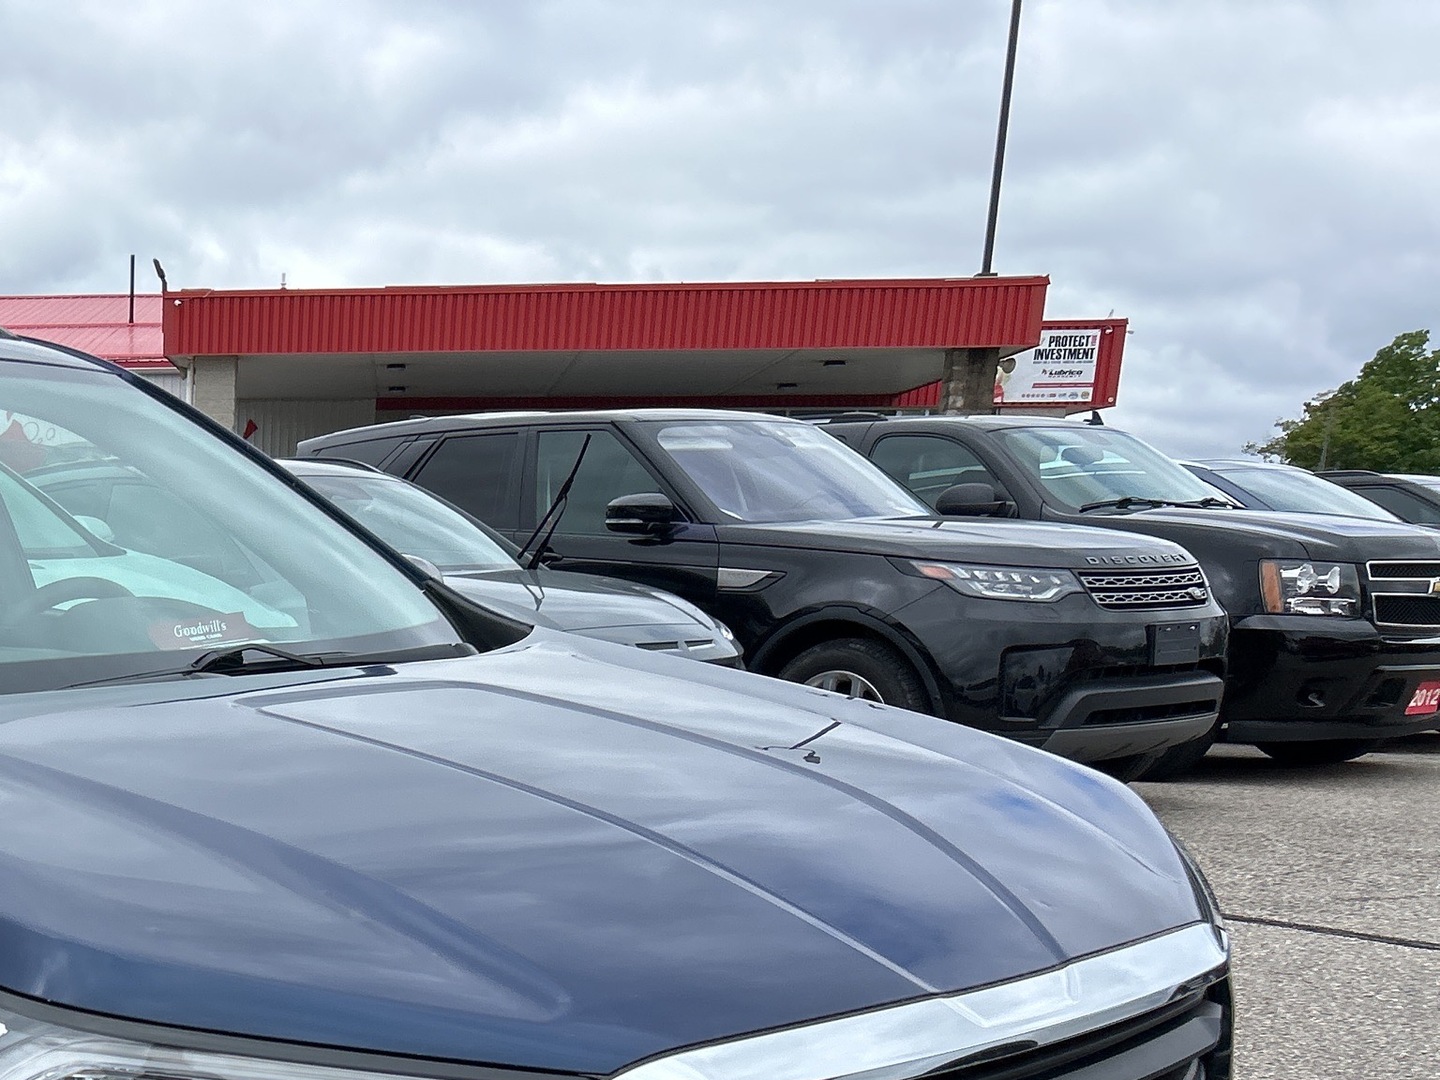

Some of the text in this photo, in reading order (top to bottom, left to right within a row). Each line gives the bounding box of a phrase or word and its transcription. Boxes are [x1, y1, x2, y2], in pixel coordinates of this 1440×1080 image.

[1048, 335, 1091, 347] PROTECT
[1033, 347, 1096, 361] INVESTMENT
[1085, 553, 1187, 565] DISCOVERY
[173, 619, 227, 637] Goodwill's
[1408, 688, 1440, 707] 2012
